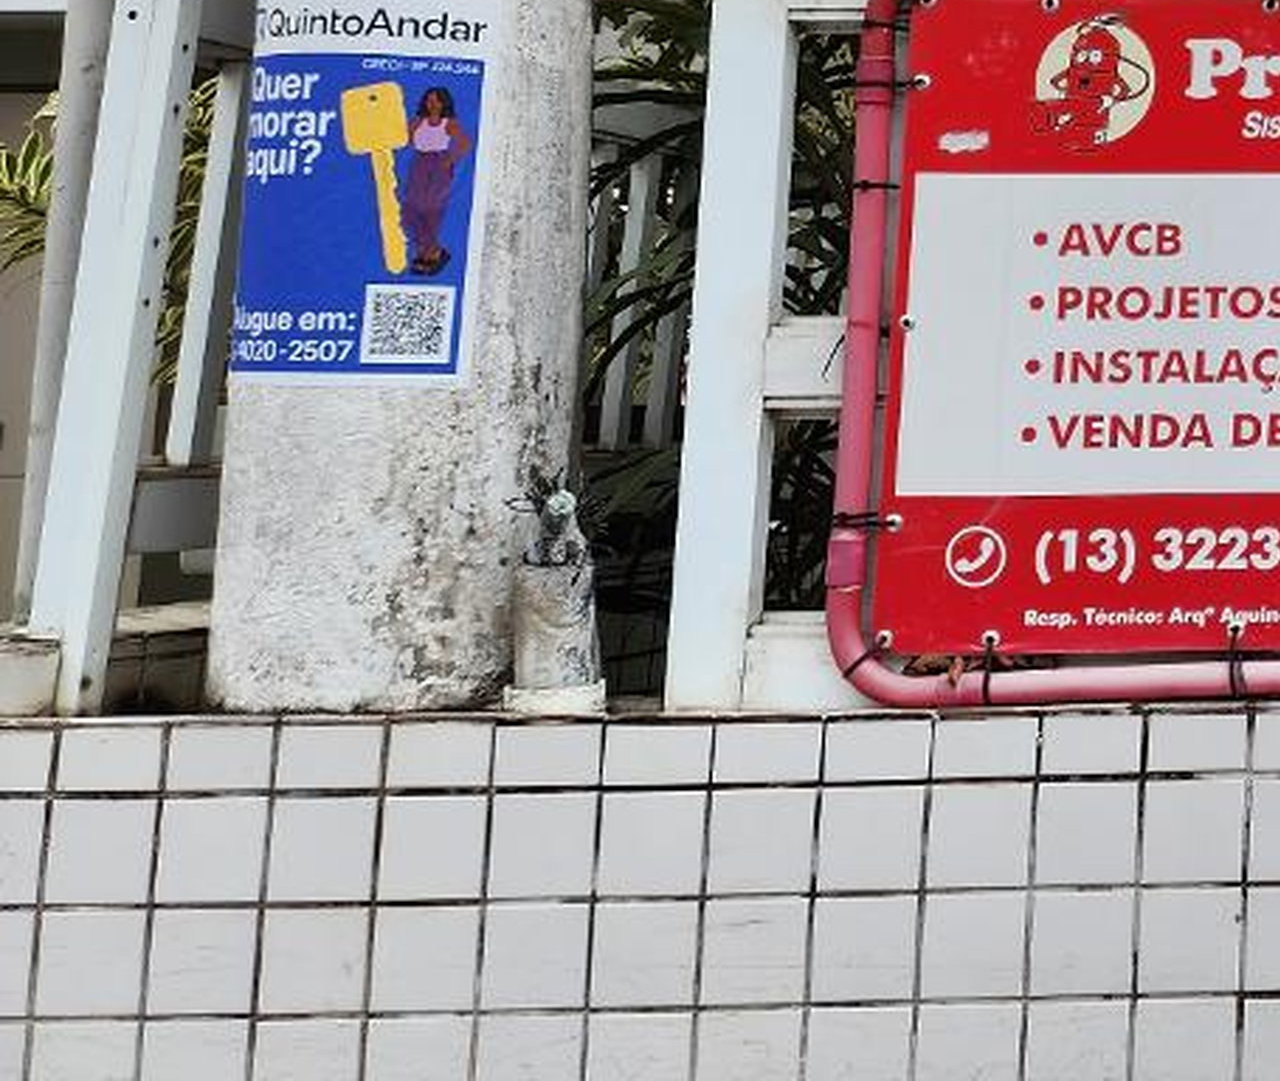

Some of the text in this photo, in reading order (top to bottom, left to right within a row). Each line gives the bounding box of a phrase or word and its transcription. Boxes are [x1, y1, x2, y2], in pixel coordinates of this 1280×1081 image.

[269, 7, 488, 43] QuintoAndar
[251, 67, 321, 103] Quer
[1057, 222, 1182, 258] AVCB
[298, 310, 357, 331] em:
[1046, 412, 1214, 449] VENDA
[1034, 527, 1137, 585] (13)
[1023, 609, 1078, 630] Resp.
